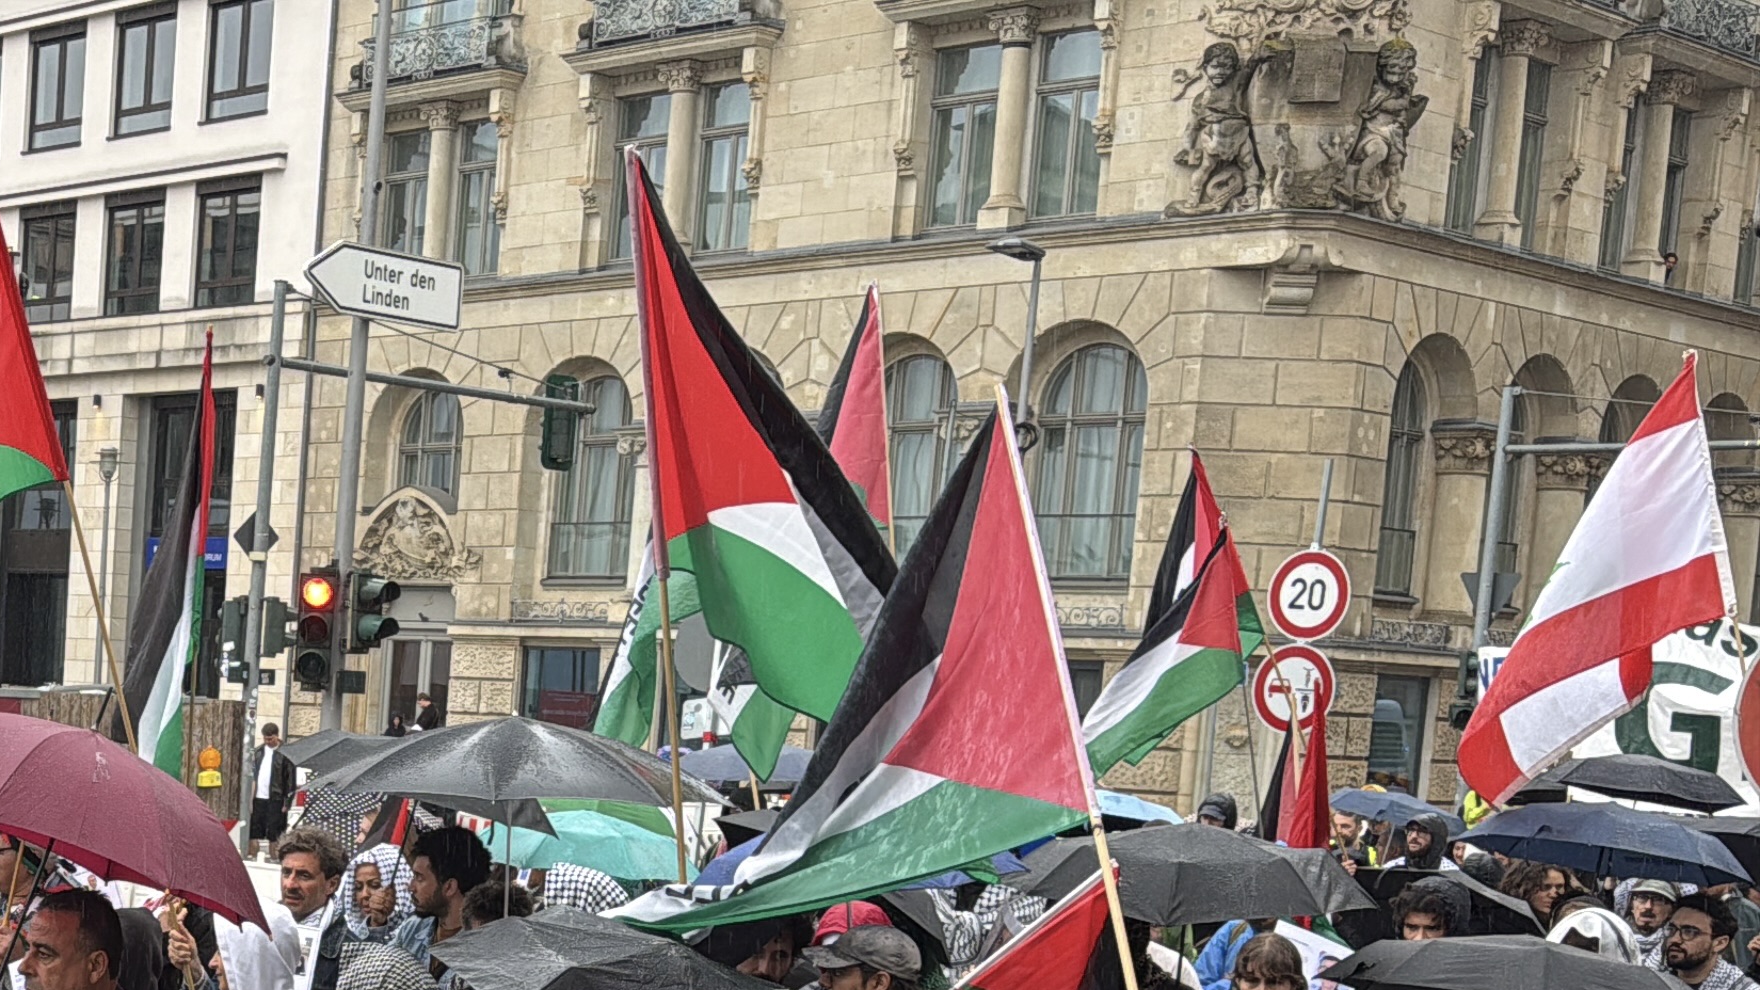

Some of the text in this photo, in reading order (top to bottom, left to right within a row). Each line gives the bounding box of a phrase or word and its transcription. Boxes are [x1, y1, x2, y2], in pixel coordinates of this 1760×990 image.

[364, 259, 436, 291] Unter den
[362, 284, 410, 311] Linden
[1287, 577, 1327, 611] 20
